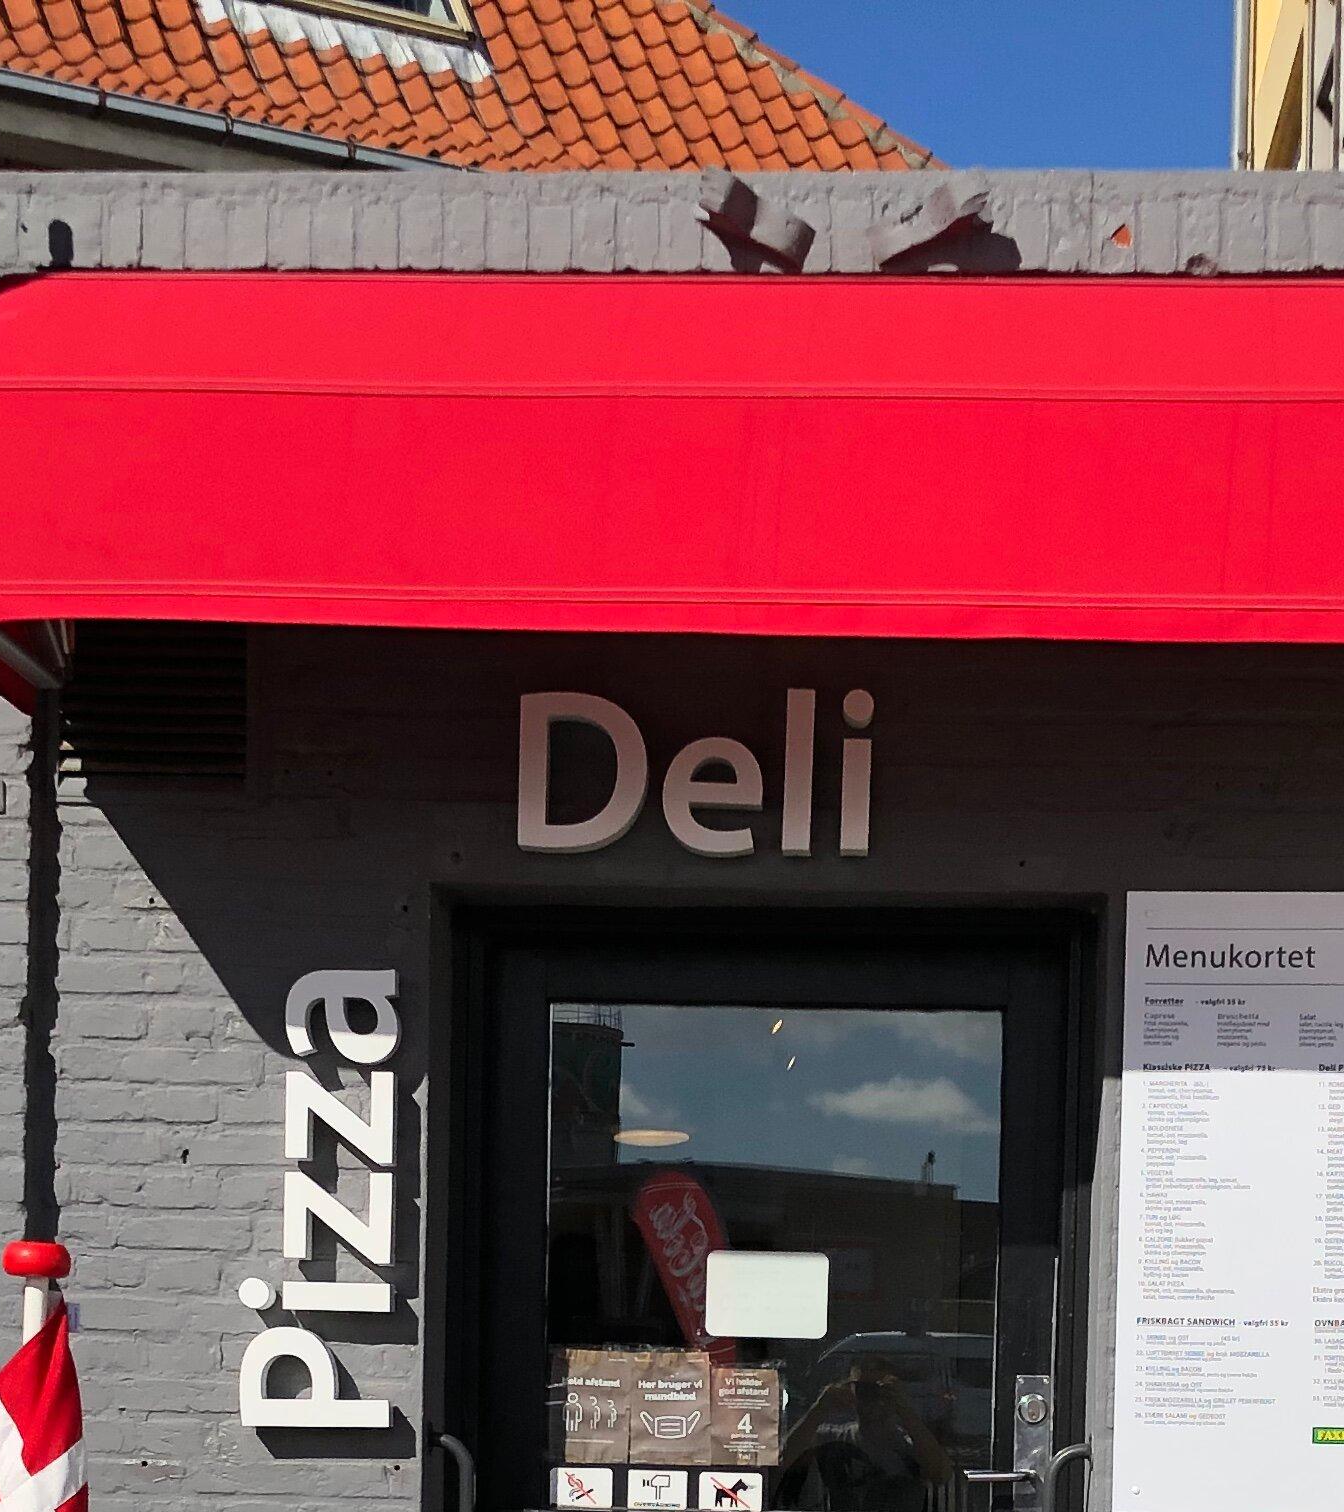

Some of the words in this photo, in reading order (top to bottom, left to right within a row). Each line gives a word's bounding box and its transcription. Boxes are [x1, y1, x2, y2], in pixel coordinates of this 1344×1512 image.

[517, 688, 875, 858] Deli
[1146, 943, 1316, 970] Menukortet
[1184, 1063, 1210, 1071] PIZZA
[239, 968, 401, 1428] Pizza
[1136, 1318, 1186, 1326] FRISKBAGT
[1187, 1318, 1235, 1326] SANDWICH
[1243, 1319, 1268, 1327] valgfri
[658, 1380, 691, 1390] bruger
[736, 1378, 763, 1386] holder
[737, 1413, 753, 1433] 4
